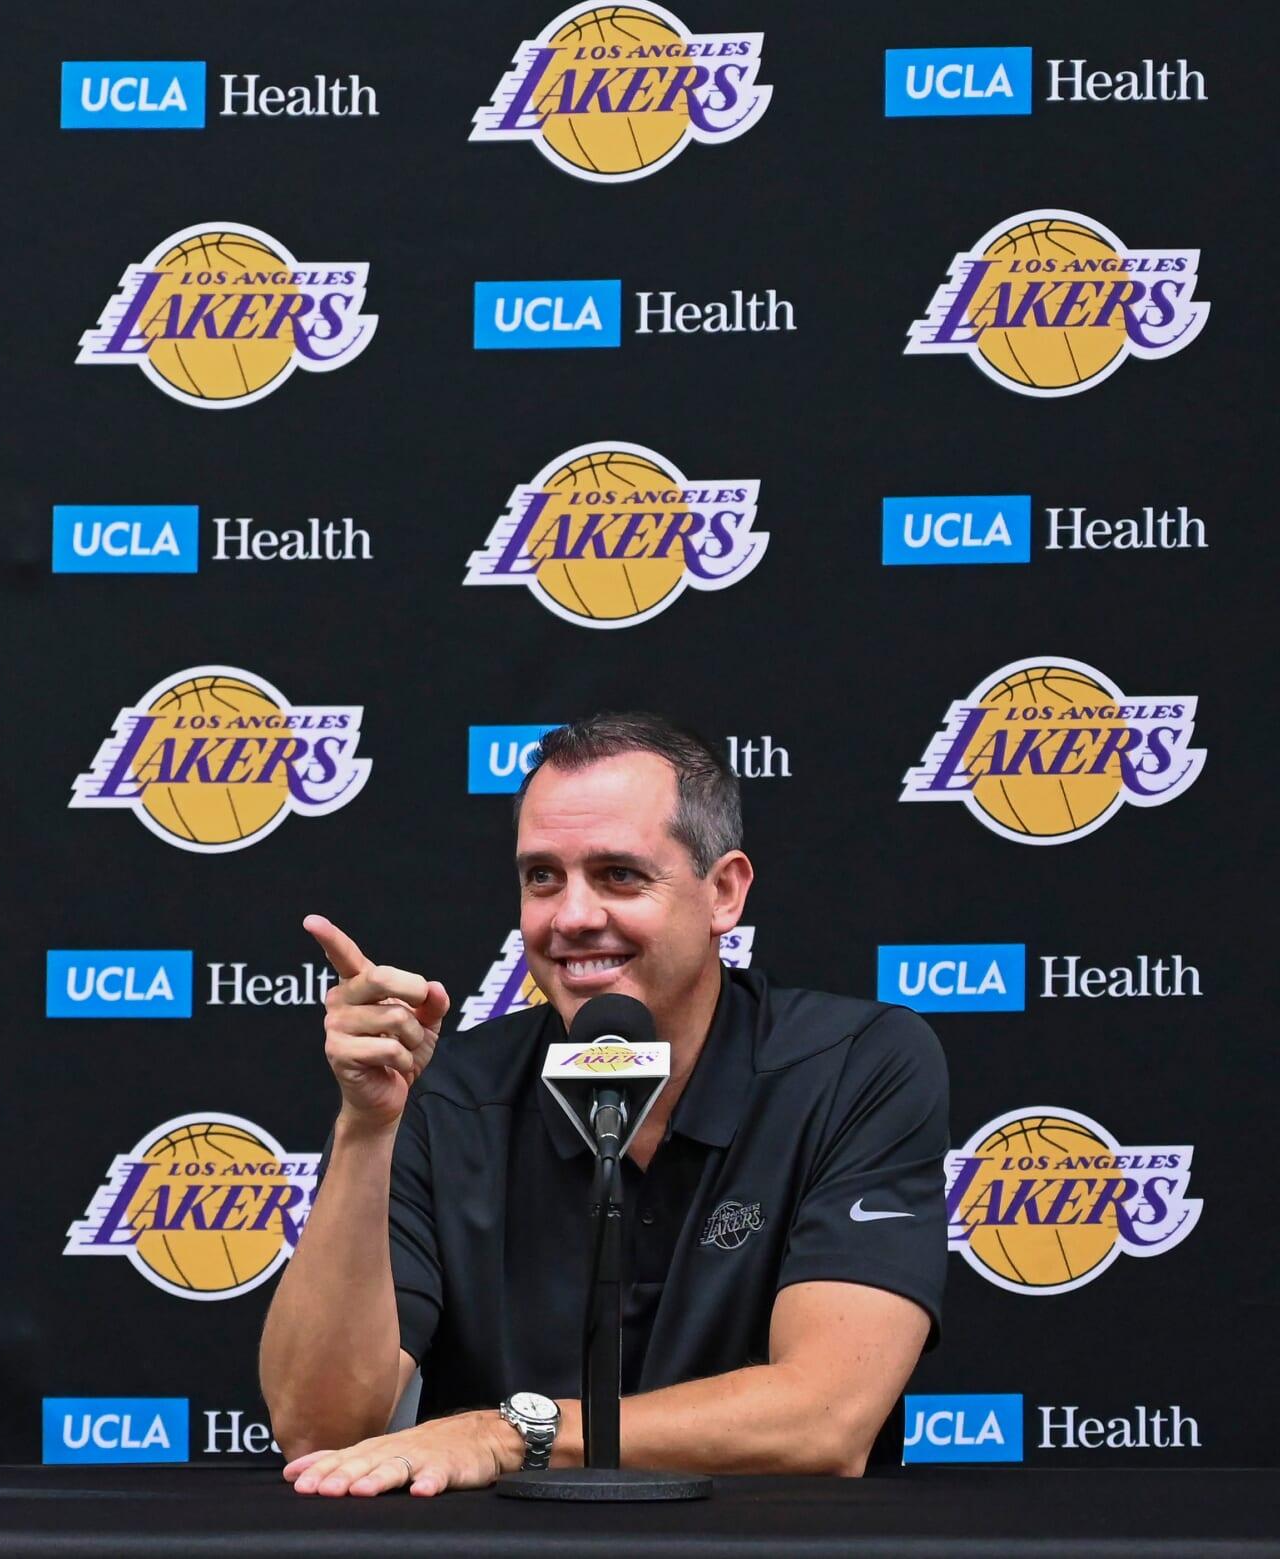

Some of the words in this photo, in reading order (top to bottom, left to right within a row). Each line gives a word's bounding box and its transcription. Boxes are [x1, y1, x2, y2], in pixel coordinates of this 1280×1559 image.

[574, 45, 622, 60] LOS
[627, 41, 751, 58] ANGELES
[81, 77, 187, 112] UCLA
[220, 75, 379, 116] Health
[485, 47, 760, 132] LAKERS
[906, 63, 1014, 100] UCLA
[1047, 59, 1208, 101] Health
[180, 272, 228, 285] LOS
[233, 270, 357, 284] ANGELES
[1009, 259, 1057, 273] LOS
[1062, 257, 1188, 272] ANGELES
[91, 272, 365, 360] LAKERS
[495, 297, 602, 332] UCLA
[635, 290, 797, 333] Health
[920, 260, 1197, 348] LAKERS
[569, 491, 617, 505] LOS
[622, 488, 748, 504] ANGELES
[73, 521, 180, 556] UCLA
[213, 518, 373, 560] Health
[479, 492, 756, 579] LAKERS
[904, 512, 1012, 548] UCLA
[1045, 507, 1208, 549] Health
[174, 715, 221, 728] LOS
[226, 714, 351, 728] ANGELES
[1006, 706, 1054, 720] LOS
[1059, 704, 1185, 720] ANGELES
[85, 715, 359, 804] LAKERS
[489, 741, 542, 777] UC
[726, 735, 792, 778] lth
[915, 707, 1193, 795] LAKERS
[67, 966, 173, 1001] UCLA
[206, 962, 336, 1006] Healt
[898, 960, 1006, 996] UCLA
[1040, 955, 1203, 997] Health
[168, 1162, 216, 1176] LOS
[221, 1161, 320, 1176] ANGEL
[1001, 1156, 1049, 1170] LOS
[1054, 1154, 1181, 1169] ANGELES
[945, 1157, 1190, 1246] LAKERS
[63, 1414, 170, 1449] UCLA
[1038, 1406, 1201, 1448] Health
